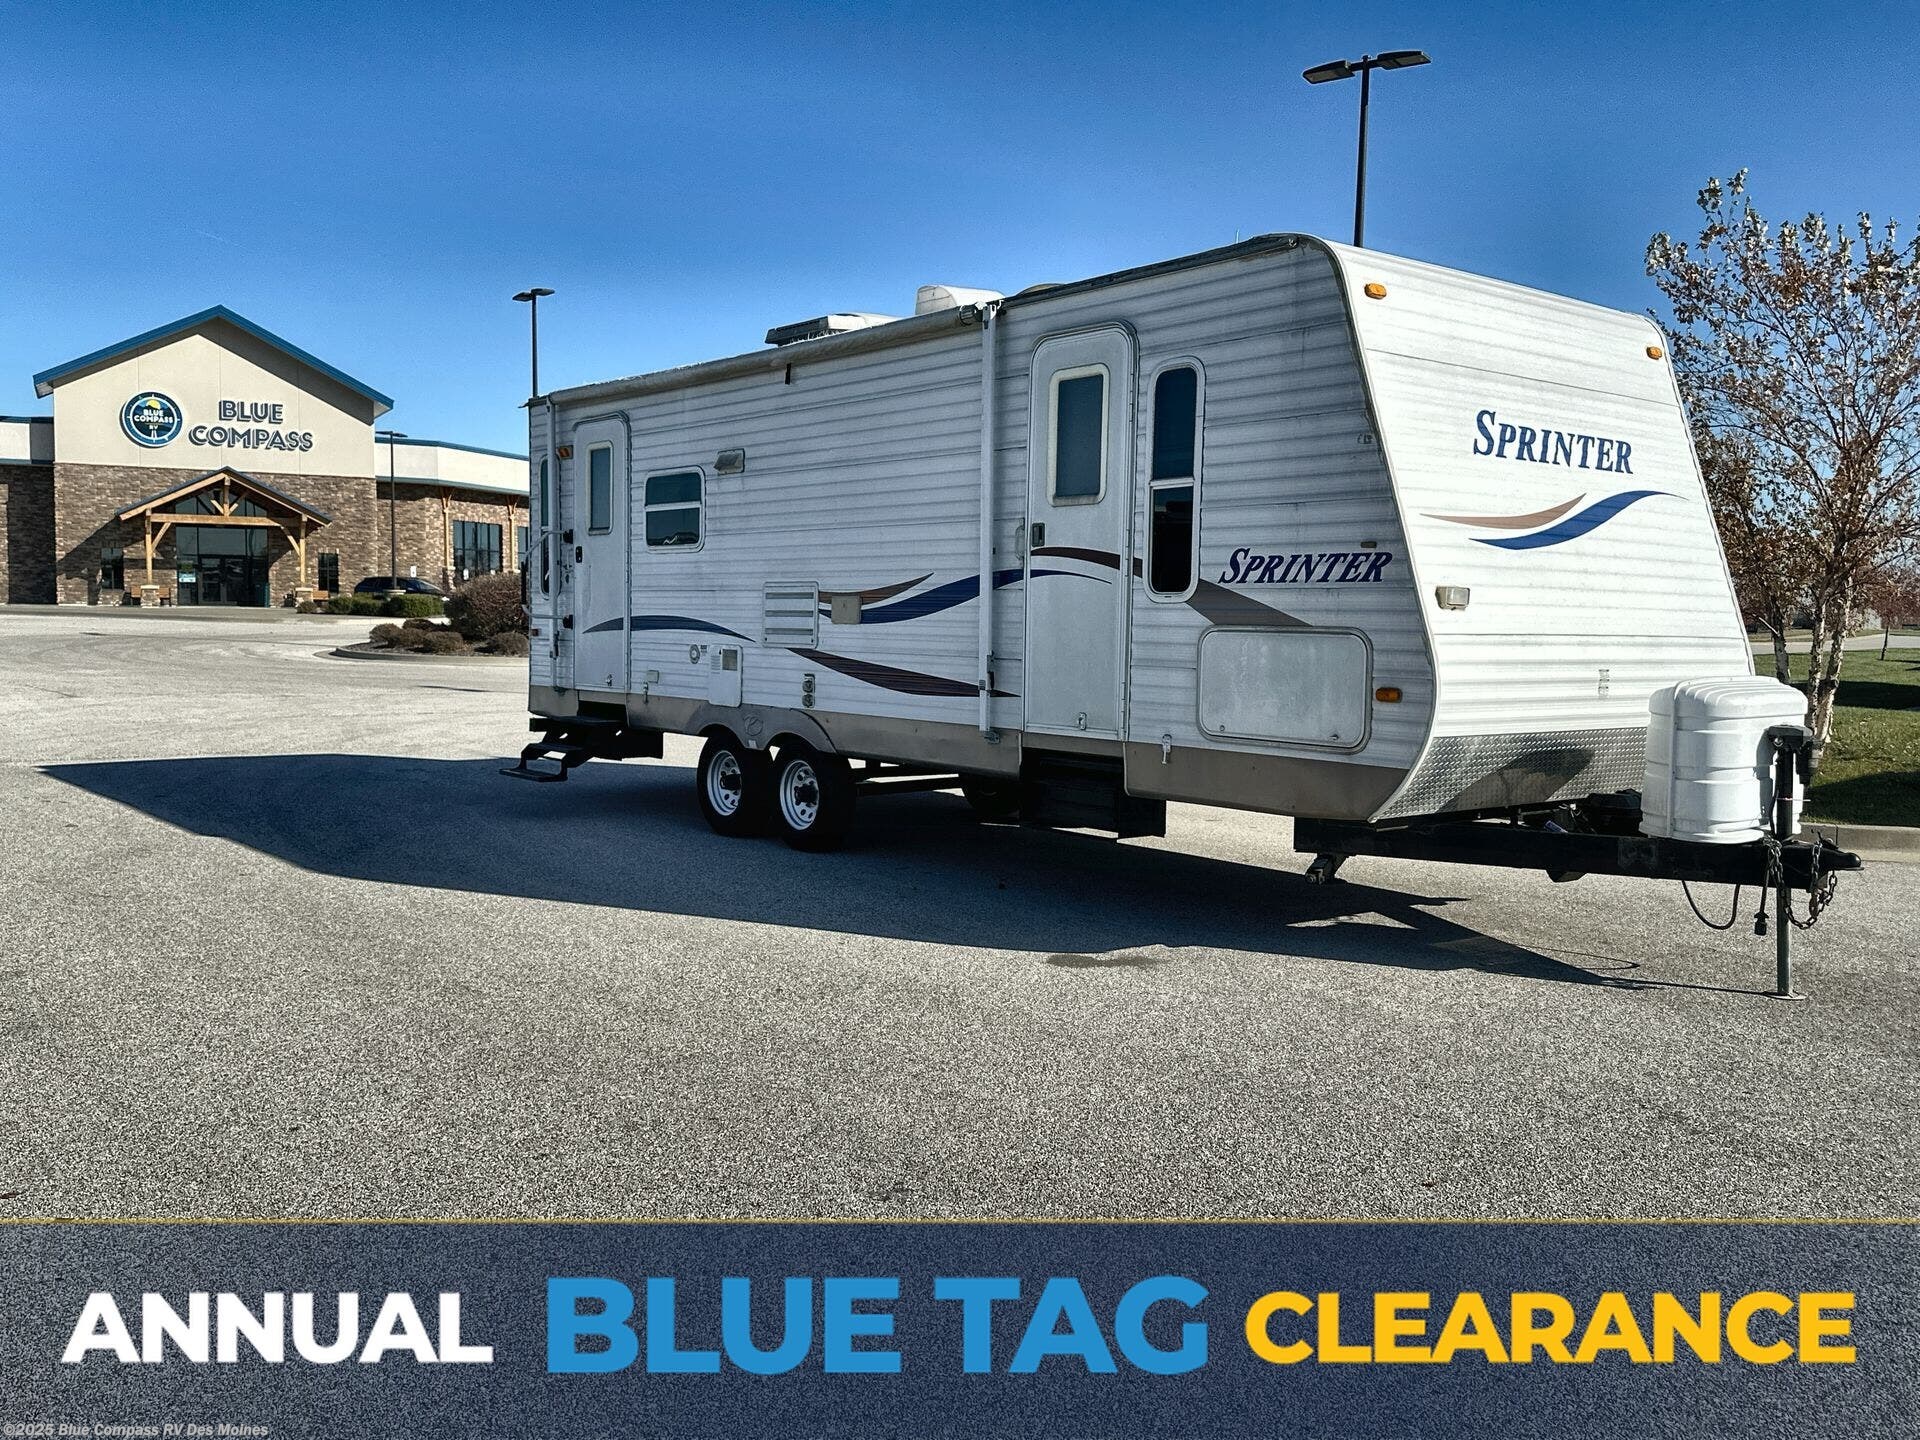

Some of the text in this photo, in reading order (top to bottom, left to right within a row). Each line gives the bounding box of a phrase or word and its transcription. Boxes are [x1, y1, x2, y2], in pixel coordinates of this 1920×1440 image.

[134, 415, 174, 424] COMPASS
[219, 400, 284, 424] BLUE
[188, 425, 314, 452] COMPASS
[1474, 410, 1633, 474] SPRINTER
[1218, 547, 1393, 584] SPRINTER
